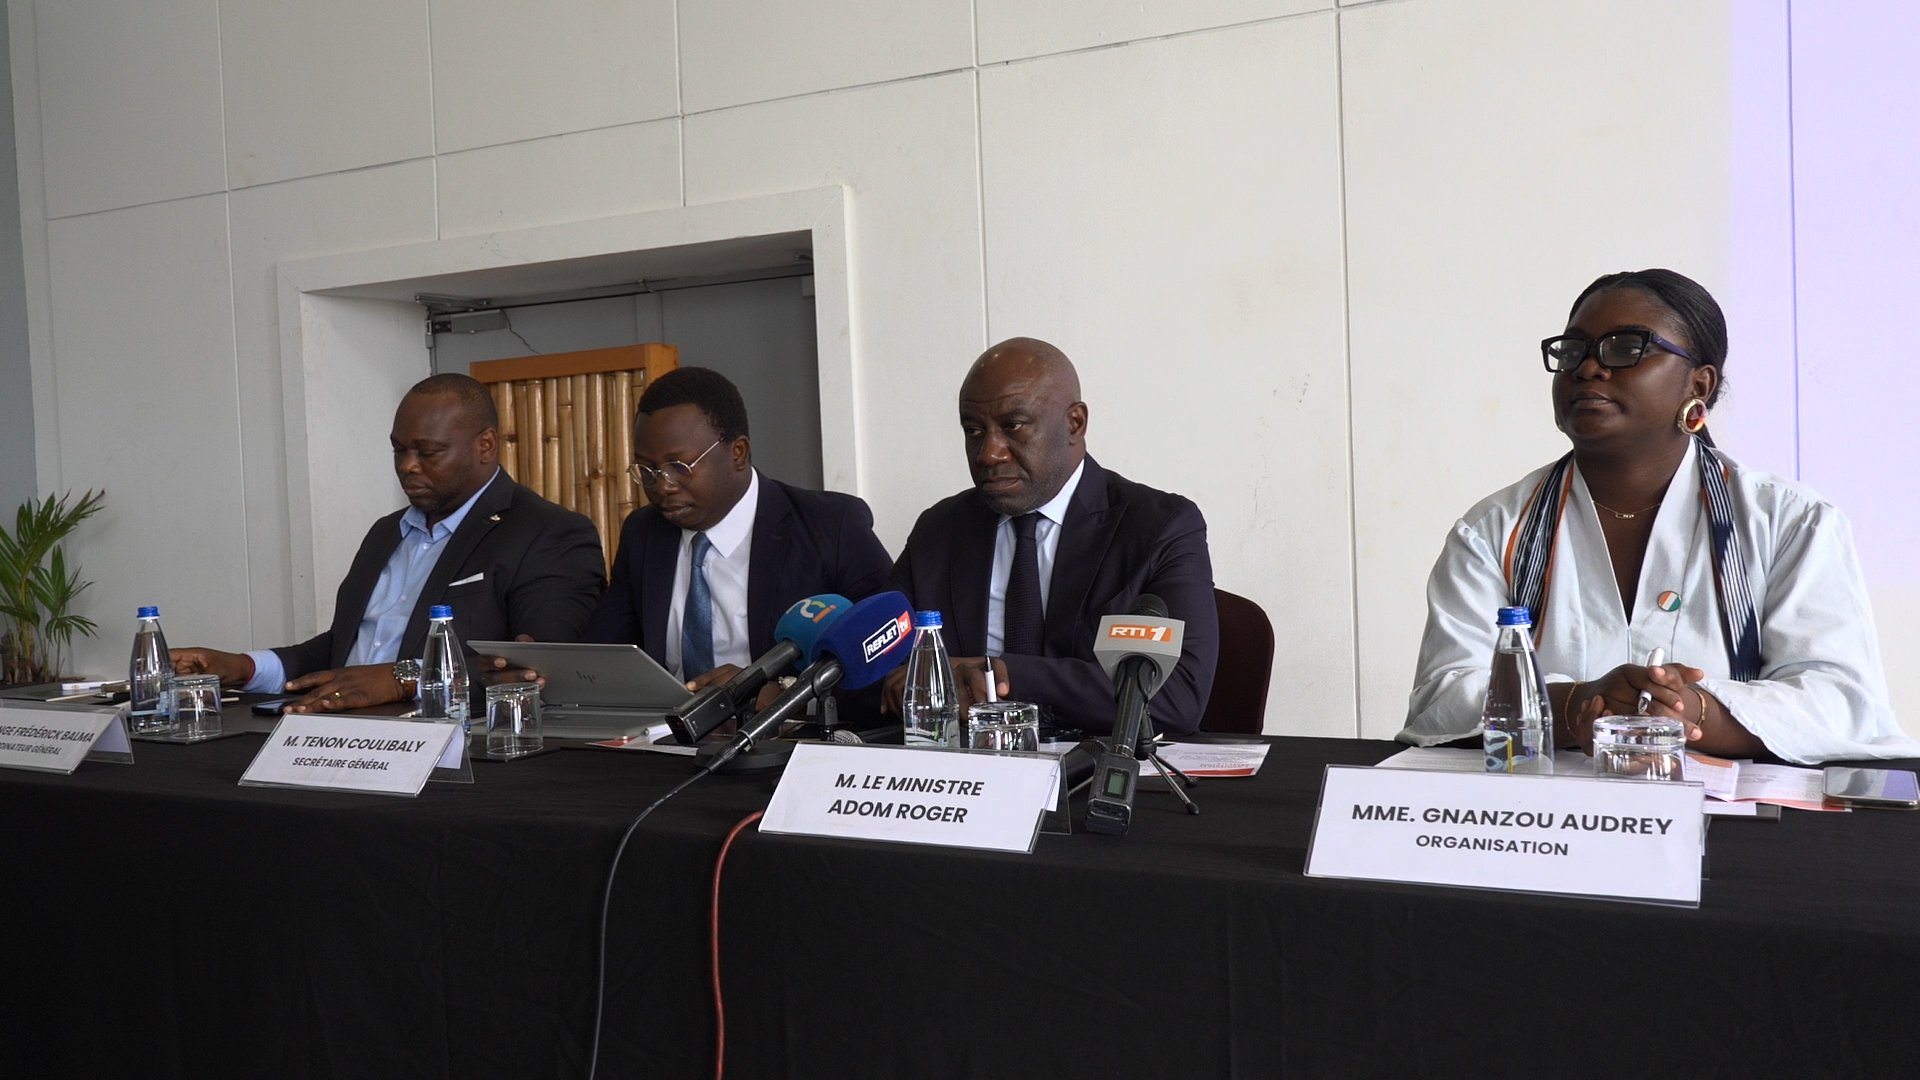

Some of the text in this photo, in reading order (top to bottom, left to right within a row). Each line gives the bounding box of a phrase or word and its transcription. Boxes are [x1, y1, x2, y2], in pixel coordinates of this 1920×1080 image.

[866, 624, 897, 656] REFLET
[1111, 626, 1167, 641] RTI 1
[13, 725, 62, 740] FRÉDÉRICK
[60, 730, 95, 743] BALMA
[283, 735, 426, 753] M. TENON COULIBALY
[292, 756, 390, 771] SECRÉTAIRE GÉNÉRAL
[834, 773, 985, 796] M. LE MINISTRE
[827, 799, 968, 823] ADOM ROGER
[1351, 804, 1673, 835] MME. GNANZOU AUDREY
[1415, 835, 1569, 856] ORGANISATION
